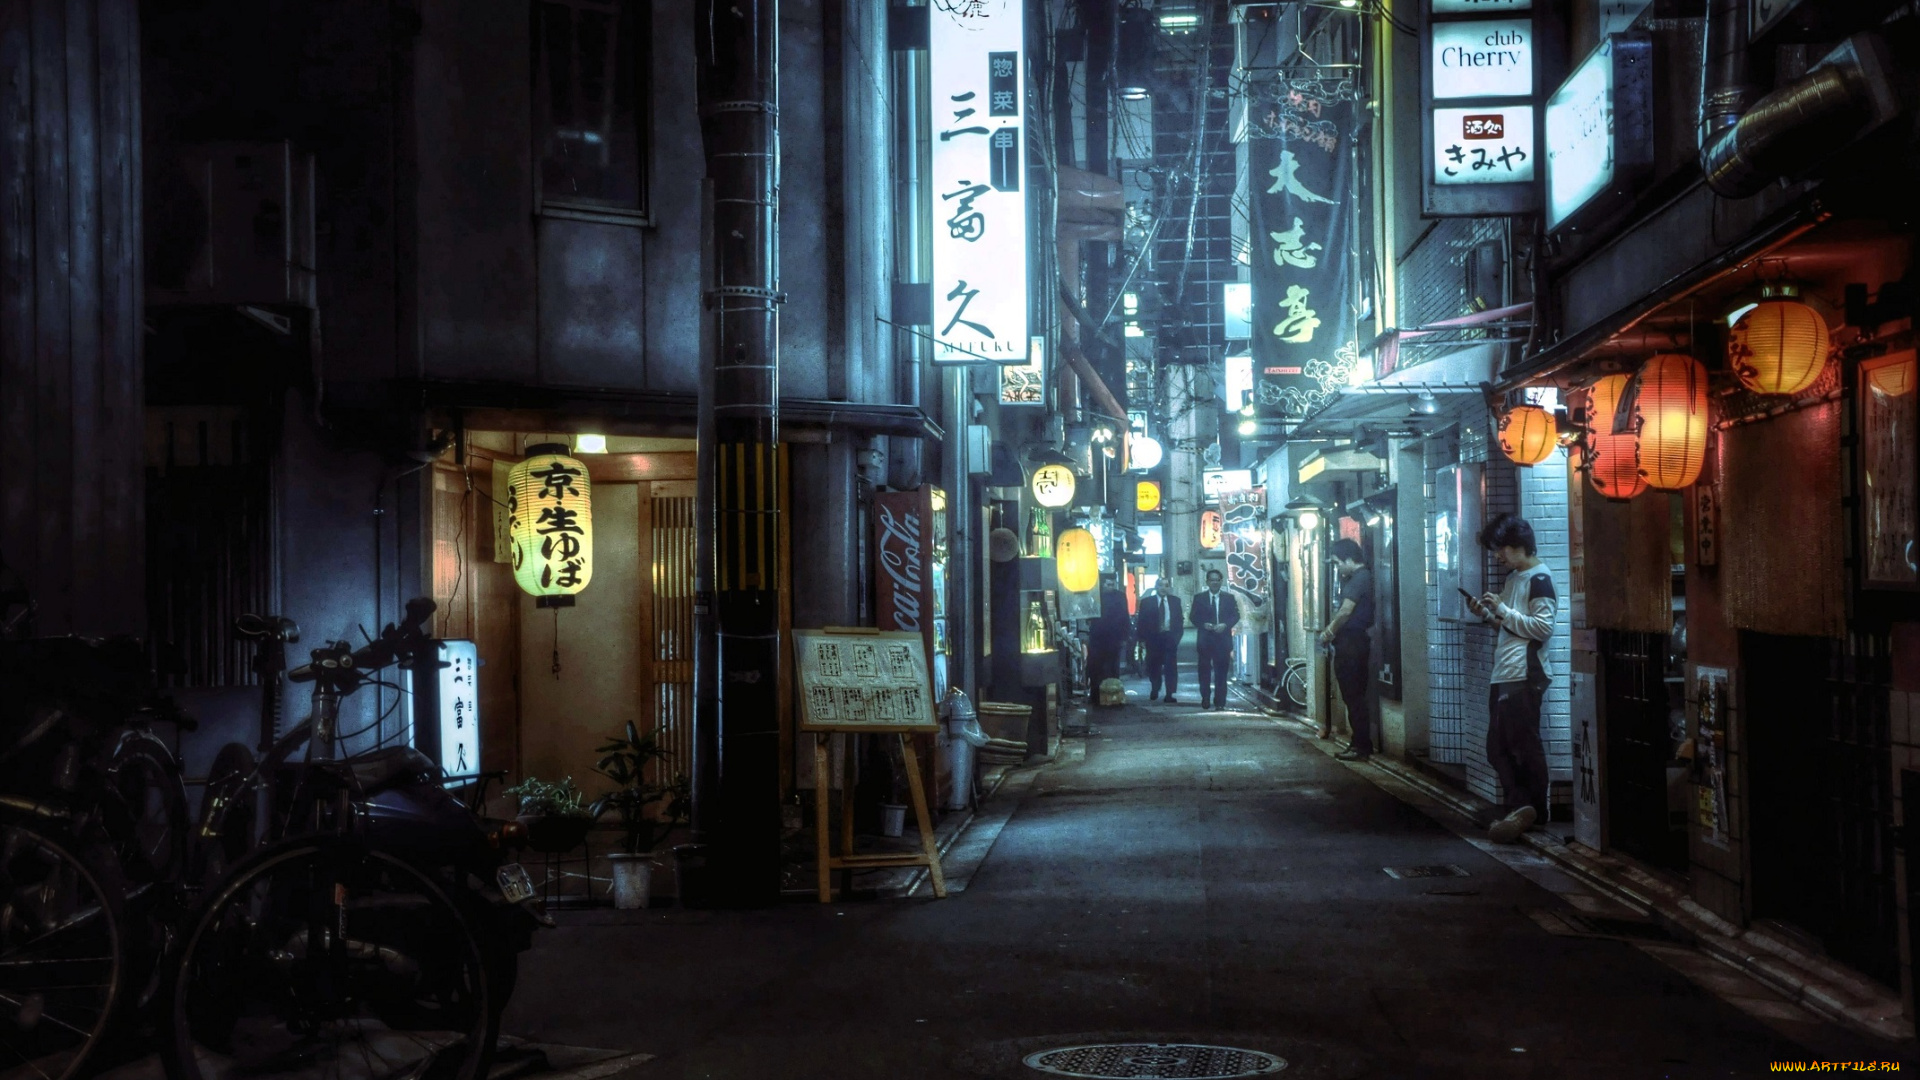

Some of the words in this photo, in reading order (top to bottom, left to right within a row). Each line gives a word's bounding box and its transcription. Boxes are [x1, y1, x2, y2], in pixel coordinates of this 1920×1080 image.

[1485, 30, 1523, 46] club
[1442, 46, 1521, 67] Cherry
[1465, 119, 1503, 135] 酒処
[1444, 144, 1527, 177] きみや
[940, 91, 995, 339] 三富久
[1266, 149, 1341, 343] 大志亭
